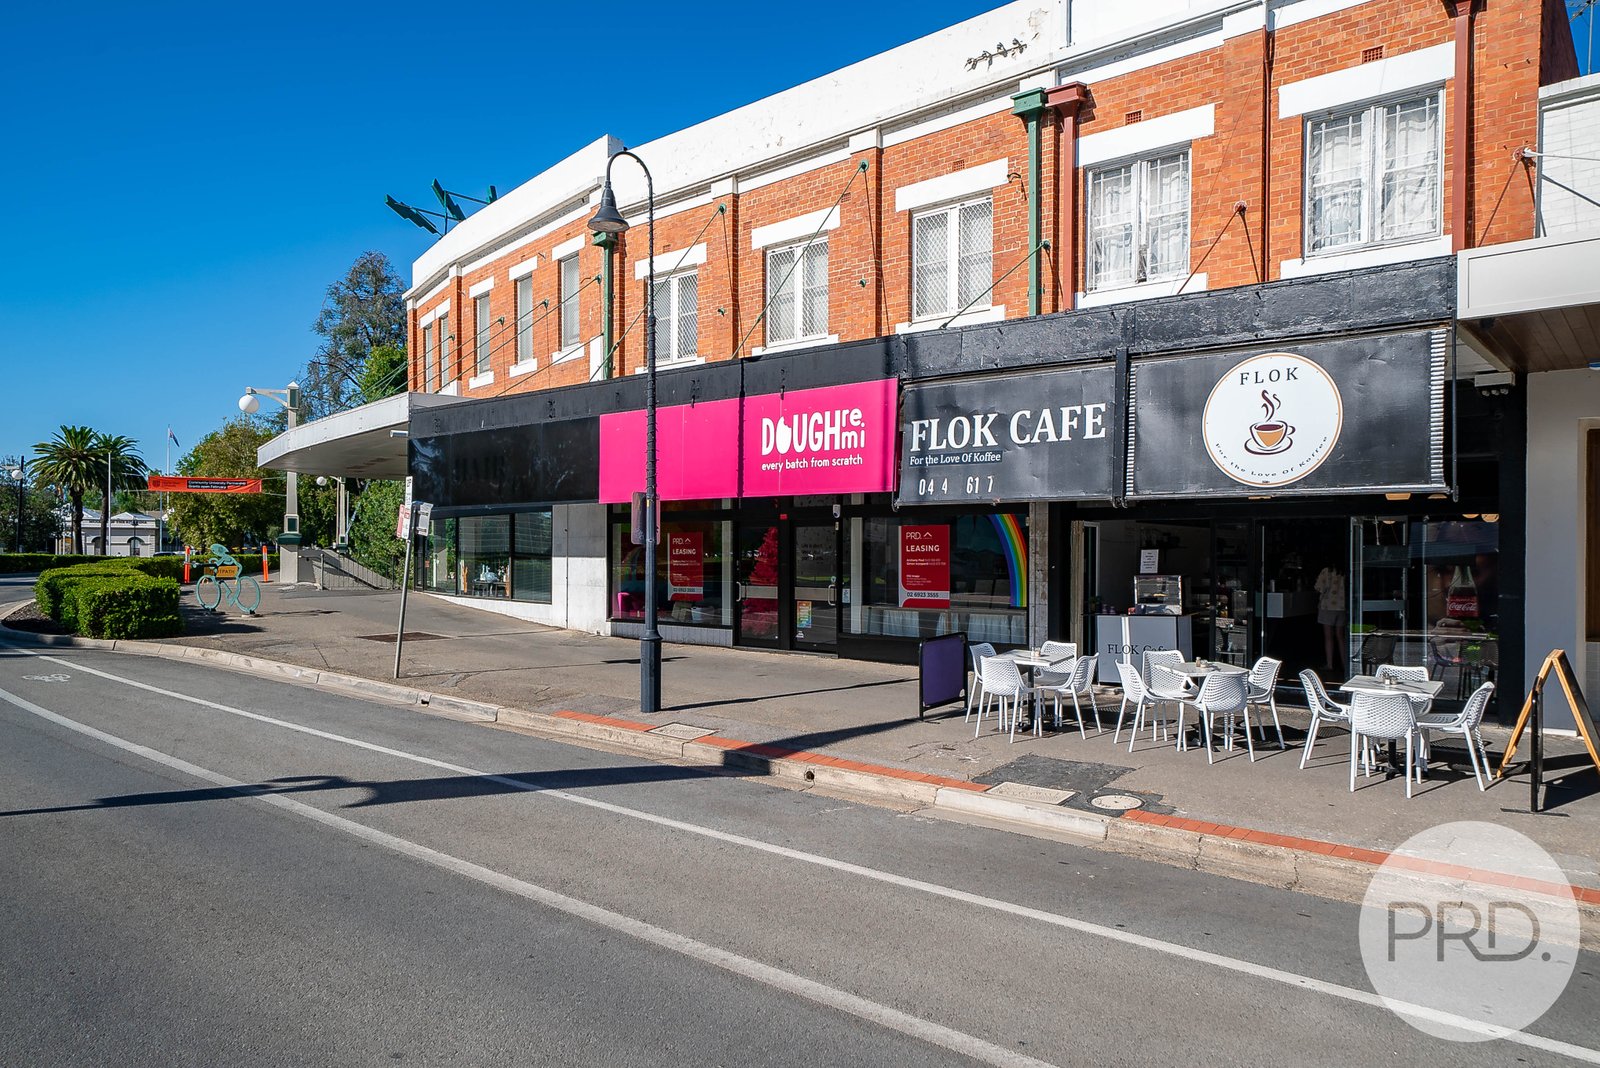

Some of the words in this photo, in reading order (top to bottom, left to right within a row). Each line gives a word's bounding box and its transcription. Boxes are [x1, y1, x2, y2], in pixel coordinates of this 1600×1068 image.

[1240, 367, 1298, 385] FLOK
[761, 410, 841, 456] DOUGH
[841, 422, 865, 450] mi
[910, 413, 998, 452] FLOK
[1009, 403, 1106, 444] CAFE
[761, 461, 784, 472] every
[785, 457, 808, 469] batch
[811, 456, 829, 467] from
[831, 453, 863, 466] scratch
[909, 455, 924, 465] For
[925, 454, 938, 465] the
[940, 453, 960, 463] Love
[961, 452, 973, 462] Of
[973, 452, 1001, 462] Koffee
[1230, 461, 1246, 472] the
[1282, 467, 1295, 475] Of
[1299, 436, 1327, 467] Koffee
[1107, 643, 1139, 655] FLOK
